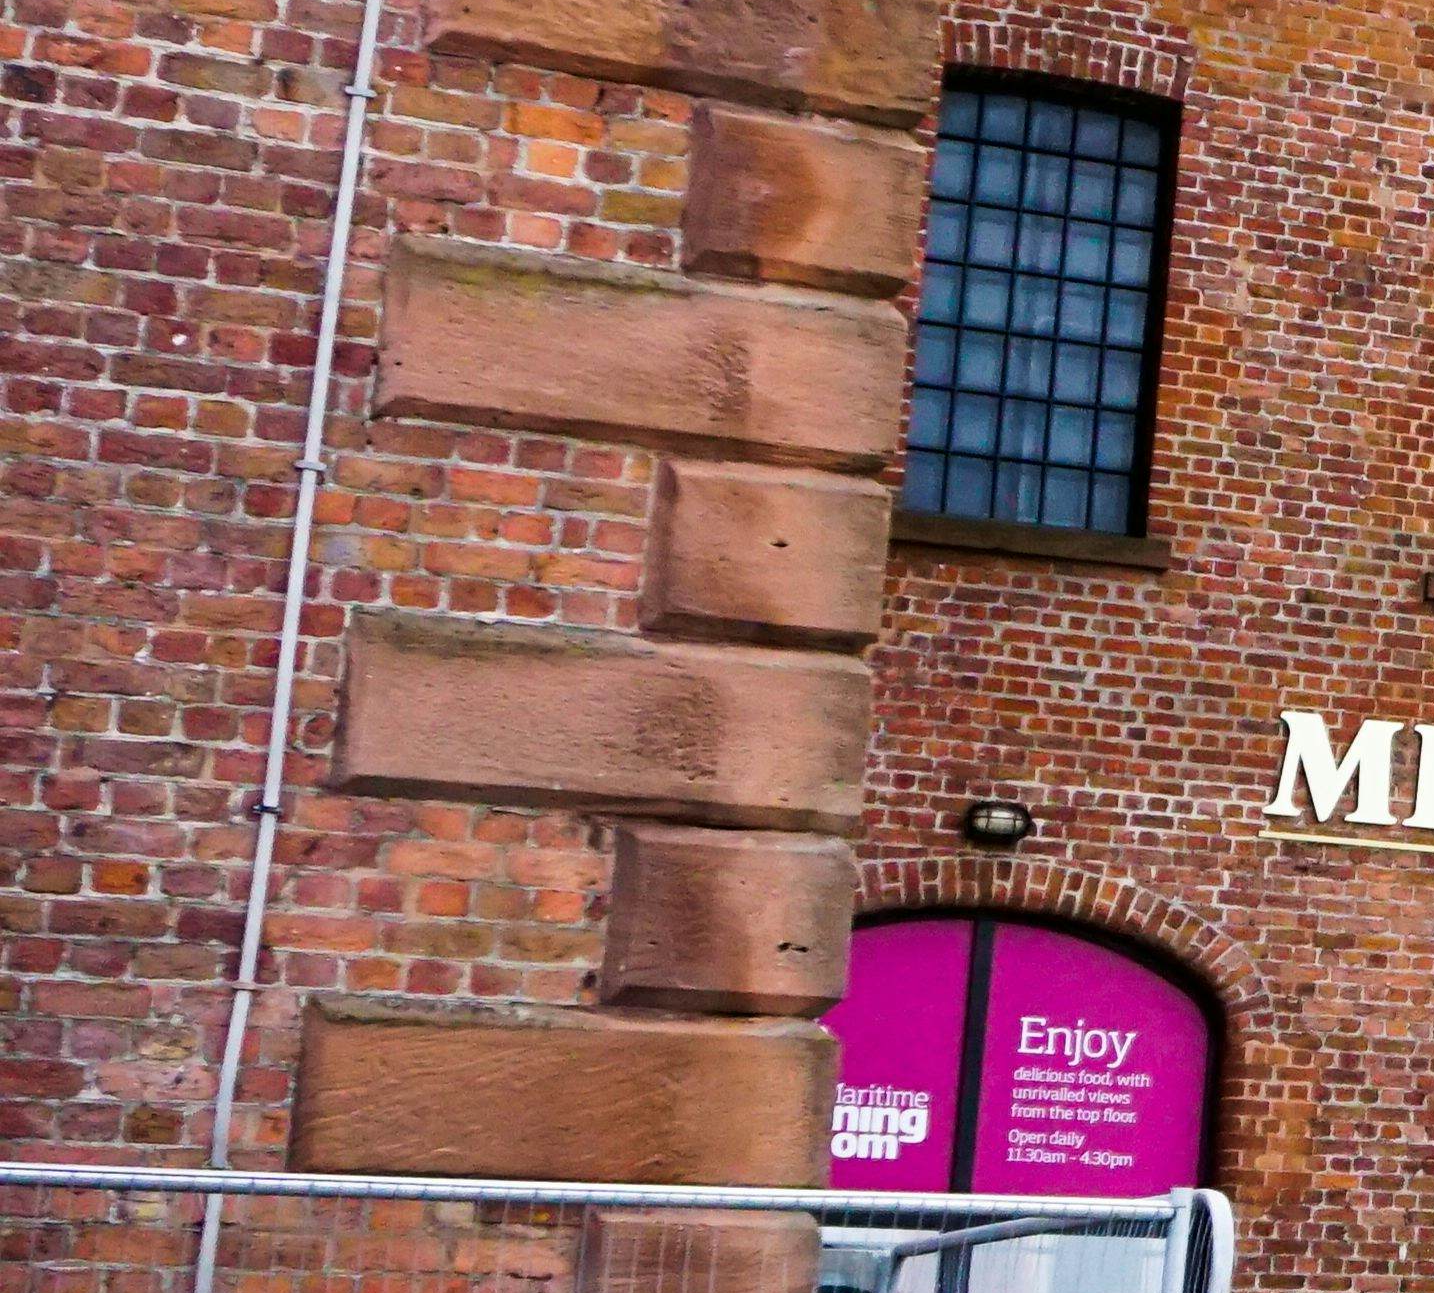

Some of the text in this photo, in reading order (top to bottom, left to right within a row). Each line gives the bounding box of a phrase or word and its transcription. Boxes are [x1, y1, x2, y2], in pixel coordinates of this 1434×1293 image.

[1017, 1016, 1137, 1068] Enjoy
[1014, 1067, 1150, 1087] delicious food, with
[1012, 1087, 1130, 1105] unrivalled views
[1011, 1104, 1046, 1121] from
[1050, 1106, 1074, 1122] the
[1077, 1108, 1099, 1124] top
[831, 1106, 929, 1144] ning
[830, 1133, 898, 1159] om
[1008, 1129, 1085, 1149] Open daily
[1007, 1147, 1066, 1164] 11.30am
[1078, 1150, 1133, 1169] 4.30pm
